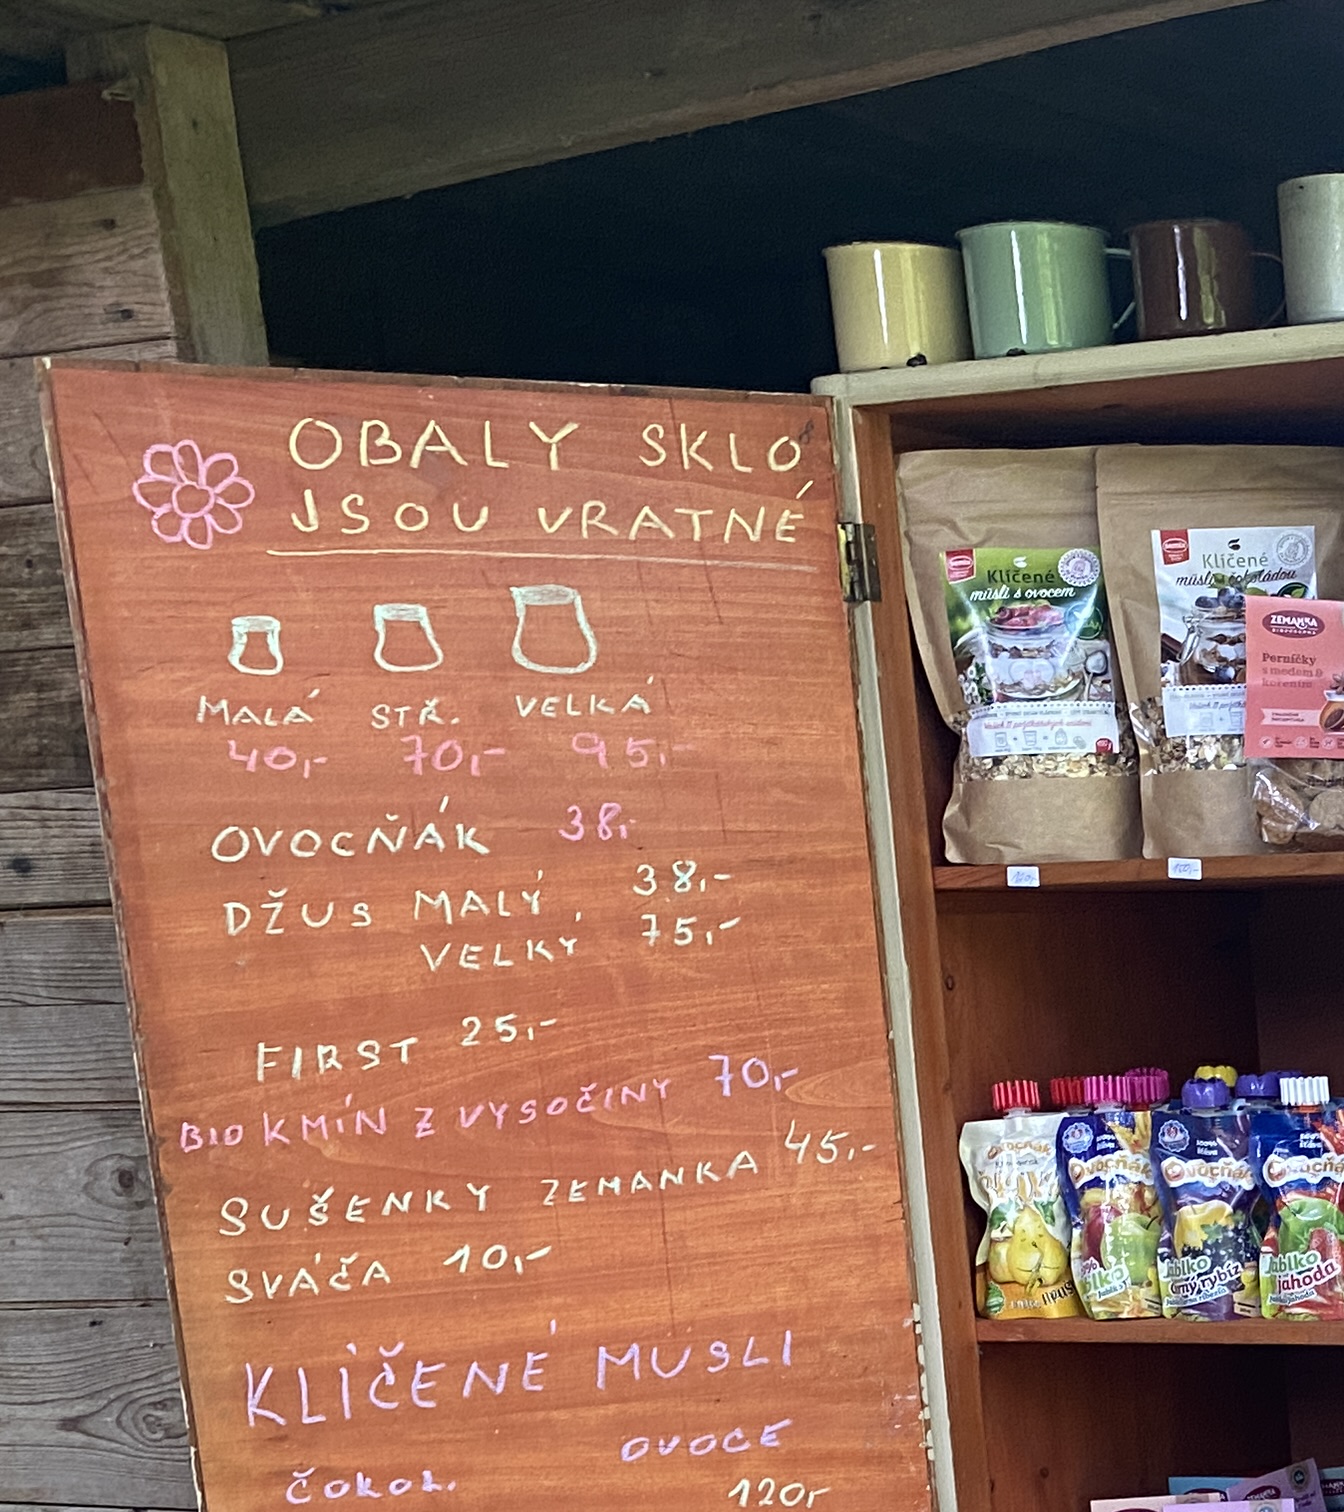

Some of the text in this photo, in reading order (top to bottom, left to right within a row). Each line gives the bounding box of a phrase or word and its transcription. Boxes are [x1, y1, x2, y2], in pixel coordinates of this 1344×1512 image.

[290, 417, 803, 471] OBALY SKLO
[292, 479, 815, 545] JSOU VRATNÉ
[987, 570, 1055, 584] Klíčené
[1202, 553, 1269, 569] Klíčené
[970, 586, 1009, 602] müsli
[1024, 586, 1076, 599] ovocem
[1269, 614, 1318, 630] ZEMANKA
[1262, 652, 1317, 667] Perníčky
[196, 676, 655, 730] MALÁ STŘ. VELKÁ
[228, 739, 327, 778] 40,-
[402, 735, 505, 776] 70,-
[211, 796, 490, 862] OVOCŇÁK
[223, 863, 733, 936] DŽUS MALÝ 38,-
[420, 909, 741, 970] VELKÝ 75,-
[257, 1016, 558, 1081] FIRST 25,-
[179, 1054, 799, 1153] BIO KMÍN Z VYSOČINY 70,-
[218, 1120, 876, 1238] SUŠENKY ZEMANKA 45,-
[224, 1242, 552, 1305] SVÁČA 10,-
[1165, 1258, 1209, 1279] Jablko
[1266, 1253, 1319, 1274] Jablko
[1278, 1260, 1337, 1292] jahoda
[245, 1319, 558, 1428] KLÍČENÉ
[621, 1419, 792, 1462] OVOCE
